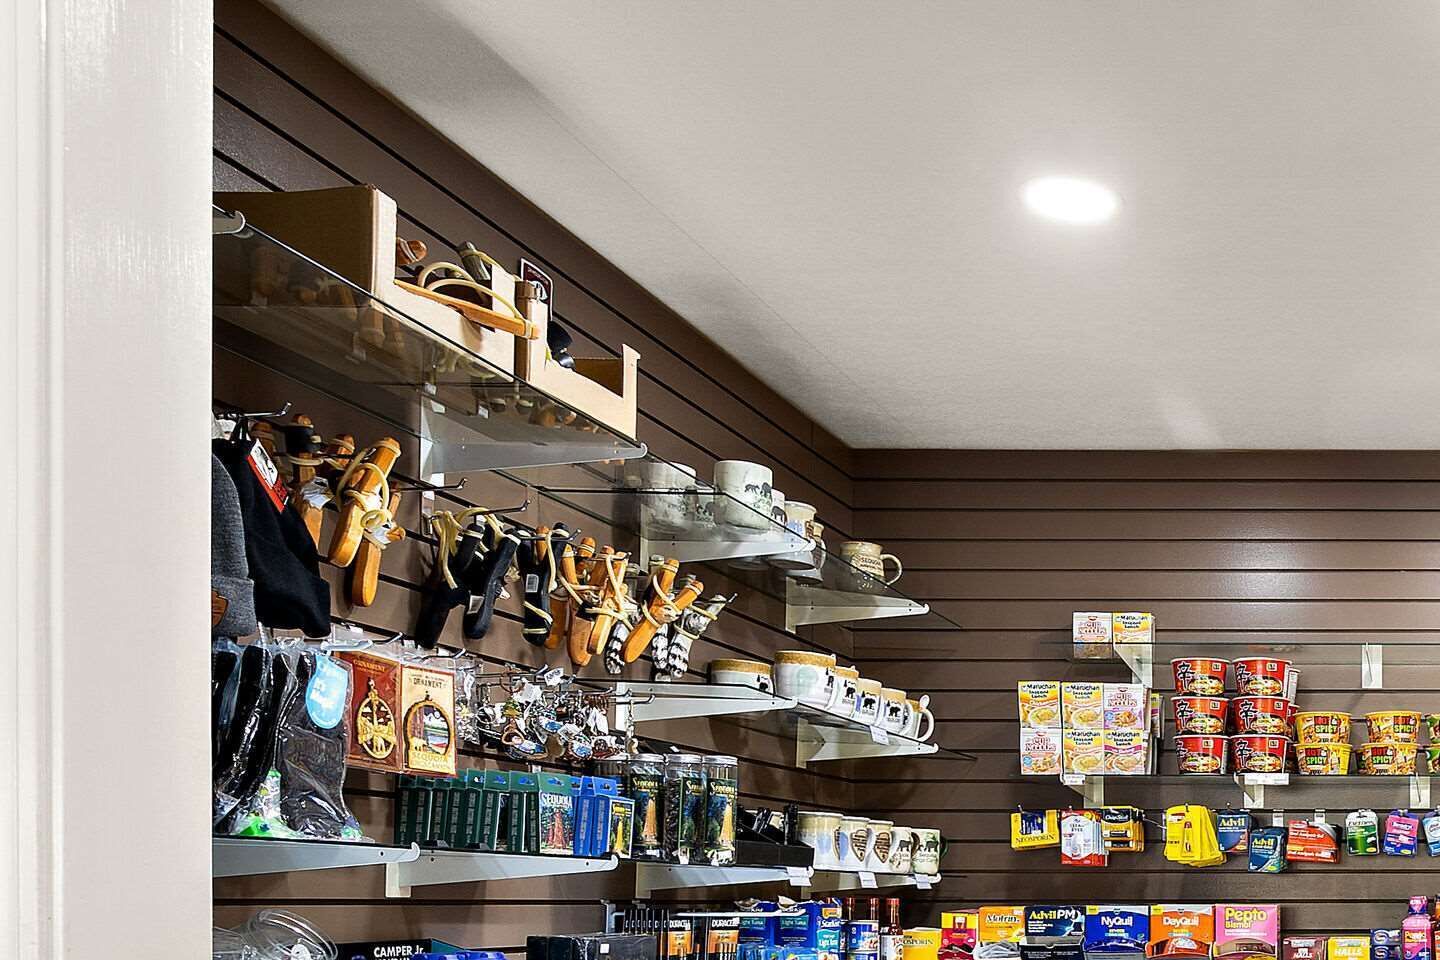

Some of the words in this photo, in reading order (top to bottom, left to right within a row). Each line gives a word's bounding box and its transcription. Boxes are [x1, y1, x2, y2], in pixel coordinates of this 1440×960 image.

[1315, 725, 1338, 733] SPICY
[1394, 725, 1415, 733] SPICY
[1306, 756, 1328, 764] SPICY
[1372, 755, 1393, 764] SPICY
[1219, 817, 1245, 827] Advil
[1015, 833, 1056, 843] NEOSPORIN
[1253, 837, 1275, 847] Advil
[986, 913, 1018, 923] Motrin
[1029, 911, 1056, 920] Advil
[1057, 910, 1076, 920] PM
[1225, 907, 1267, 922] Pepto
[1101, 916, 1132, 928] NyQuil
[1163, 916, 1199, 928] DayQuil
[1225, 921, 1251, 929] Bismol
[373, 946, 413, 957] CAMPER
[415, 945, 426, 955] Jr.
